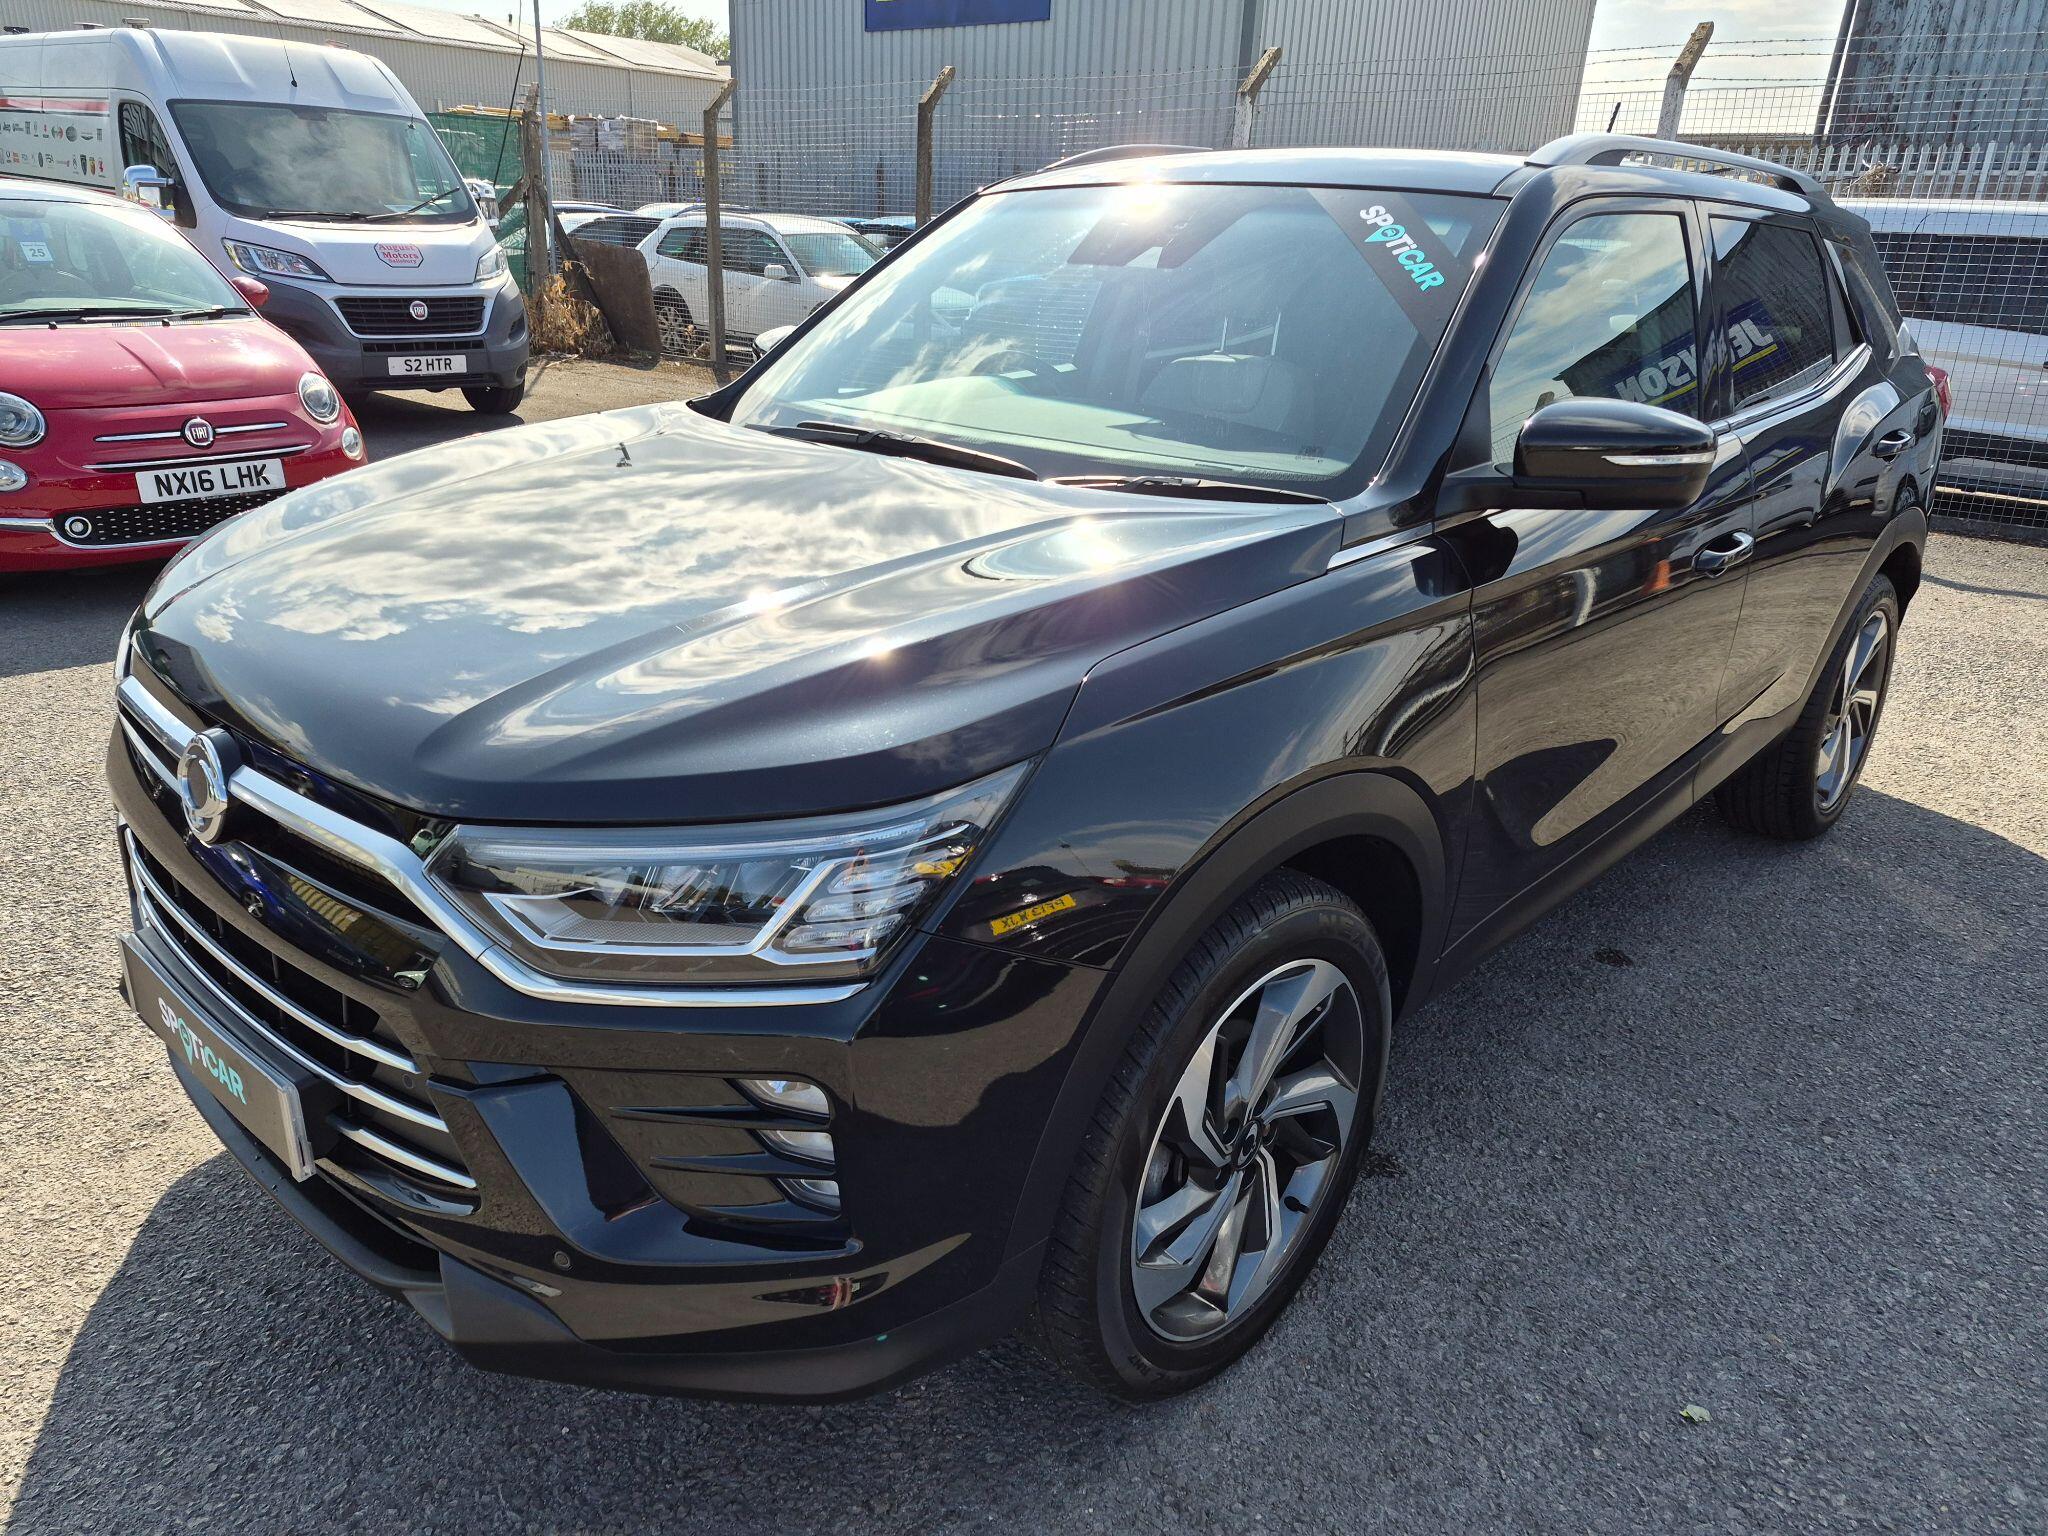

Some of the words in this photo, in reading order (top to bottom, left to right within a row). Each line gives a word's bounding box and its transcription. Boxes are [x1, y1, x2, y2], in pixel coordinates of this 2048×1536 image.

[30, 249, 46, 257] 25
[379, 243, 414, 252] August
[383, 251, 419, 259] Motors
[404, 359, 422, 372] S2
[426, 358, 452, 371] HTR
[191, 426, 208, 439] FIAT
[154, 469, 215, 497] NX16
[219, 463, 271, 490] LHK
